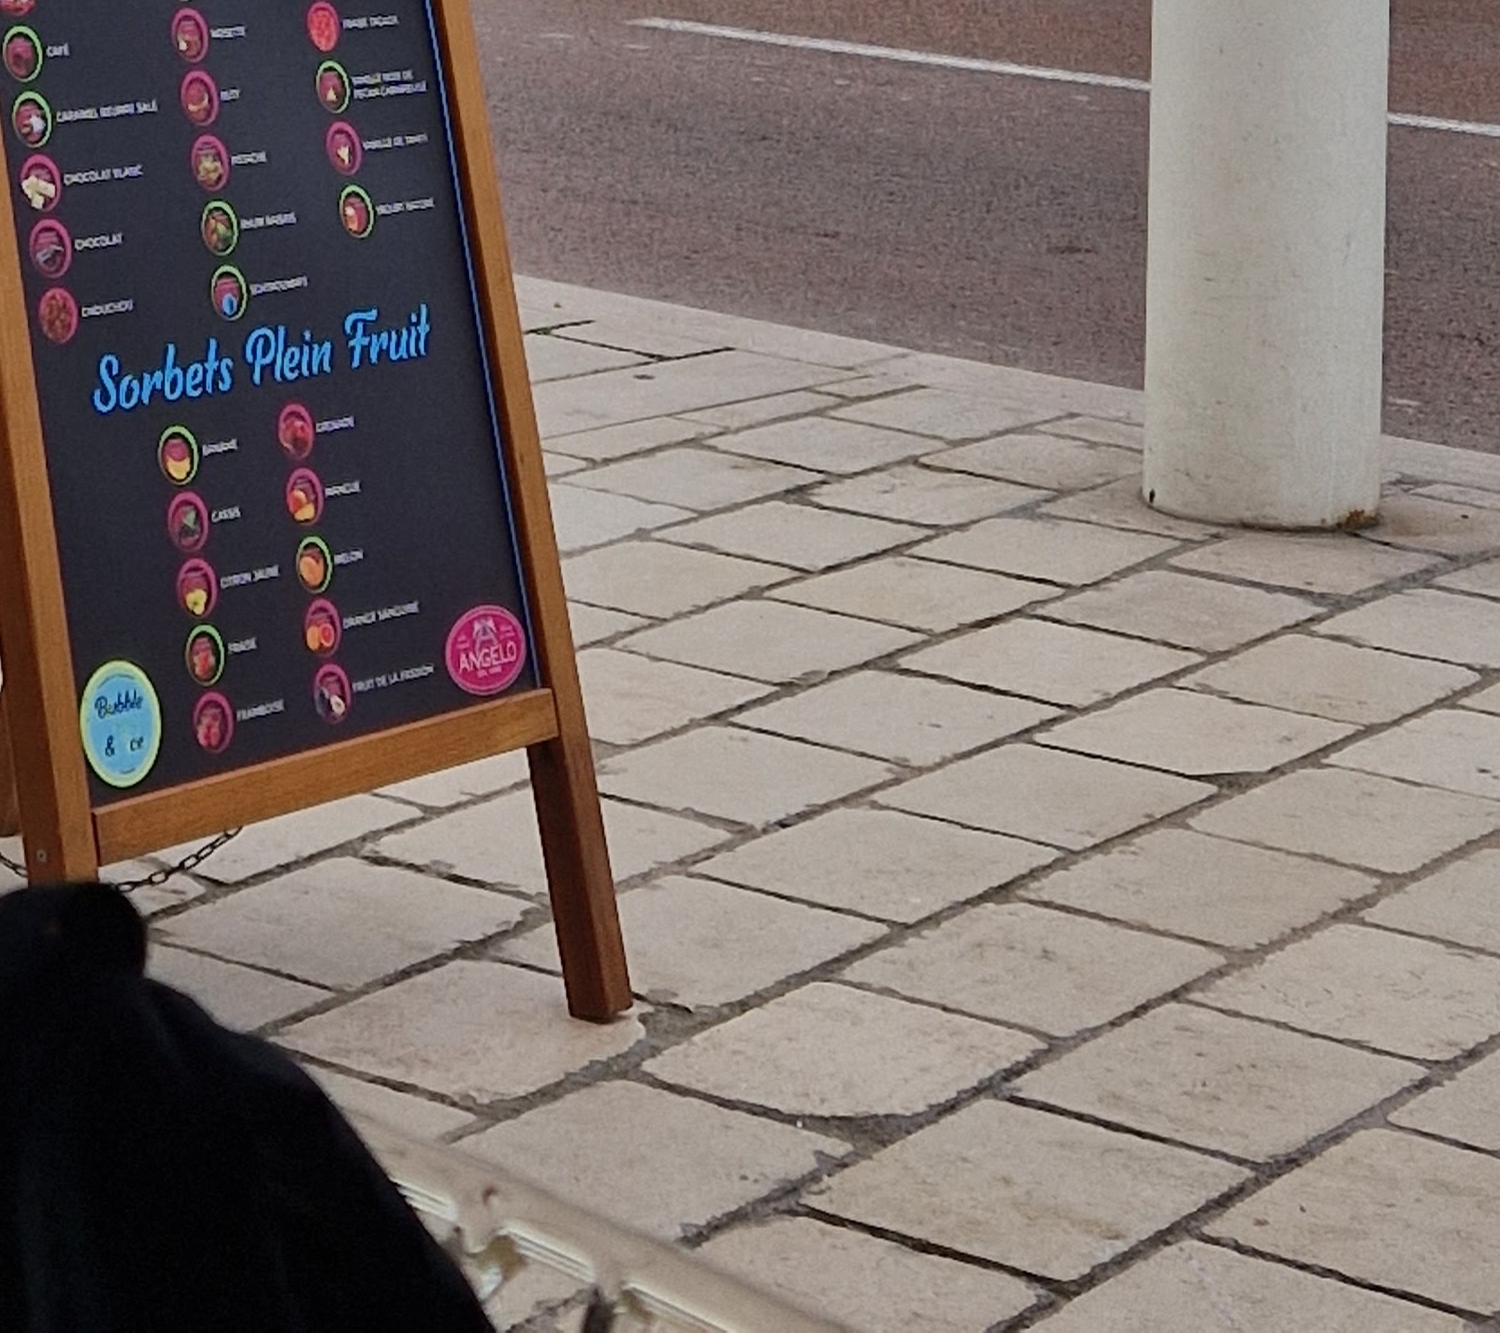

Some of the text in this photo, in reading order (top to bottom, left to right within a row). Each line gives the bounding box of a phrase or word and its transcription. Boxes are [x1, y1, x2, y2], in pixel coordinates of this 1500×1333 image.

[93, 303, 431, 414] Sorbets Plein Fruit
[459, 640, 517, 674] ANGELO
